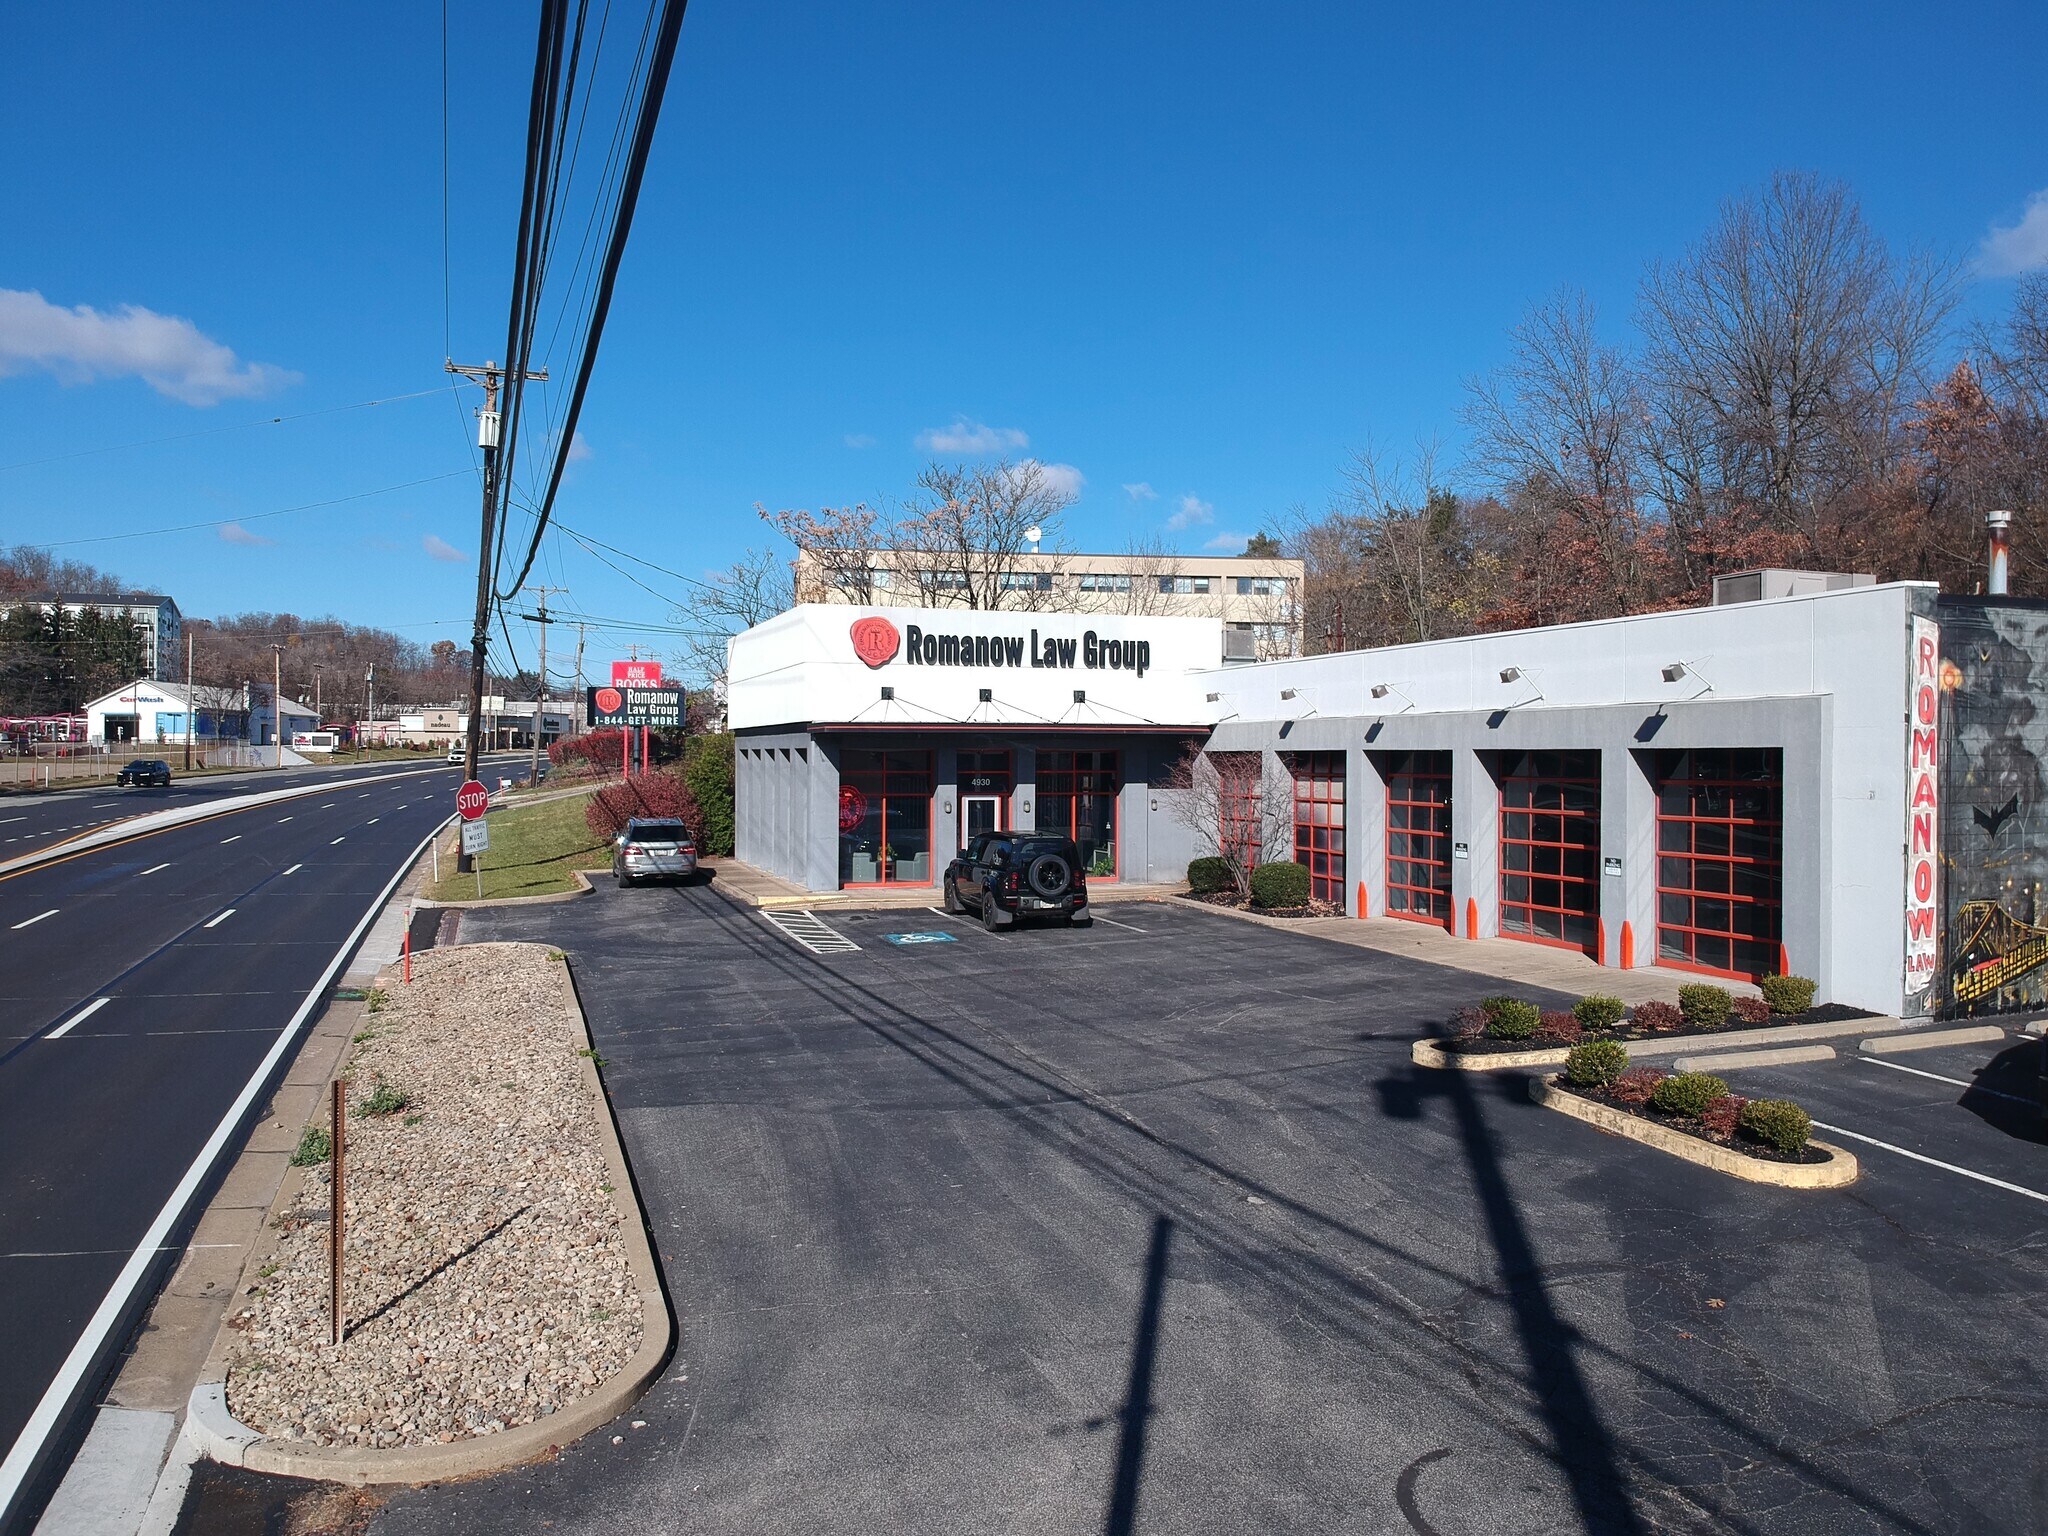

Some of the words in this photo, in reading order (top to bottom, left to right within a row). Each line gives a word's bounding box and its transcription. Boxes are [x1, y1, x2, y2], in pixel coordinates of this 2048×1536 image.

[907, 624, 1024, 667] Romanow
[1031, 629, 1077, 668] Law
[1083, 630, 1150, 678] Group
[615, 679, 657, 688] BOOKS
[627, 688, 678, 705] Romanow
[627, 705, 647, 714] Law
[649, 704, 679, 716] Group
[594, 716, 679, 725] 1-844-GET-MORE
[971, 778, 991, 786] 4930
[1906, 636, 1936, 941] ROMANOW
[459, 791, 486, 810] STOP
[468, 833, 483, 842] MUST
[1907, 951, 1936, 974] LAW
